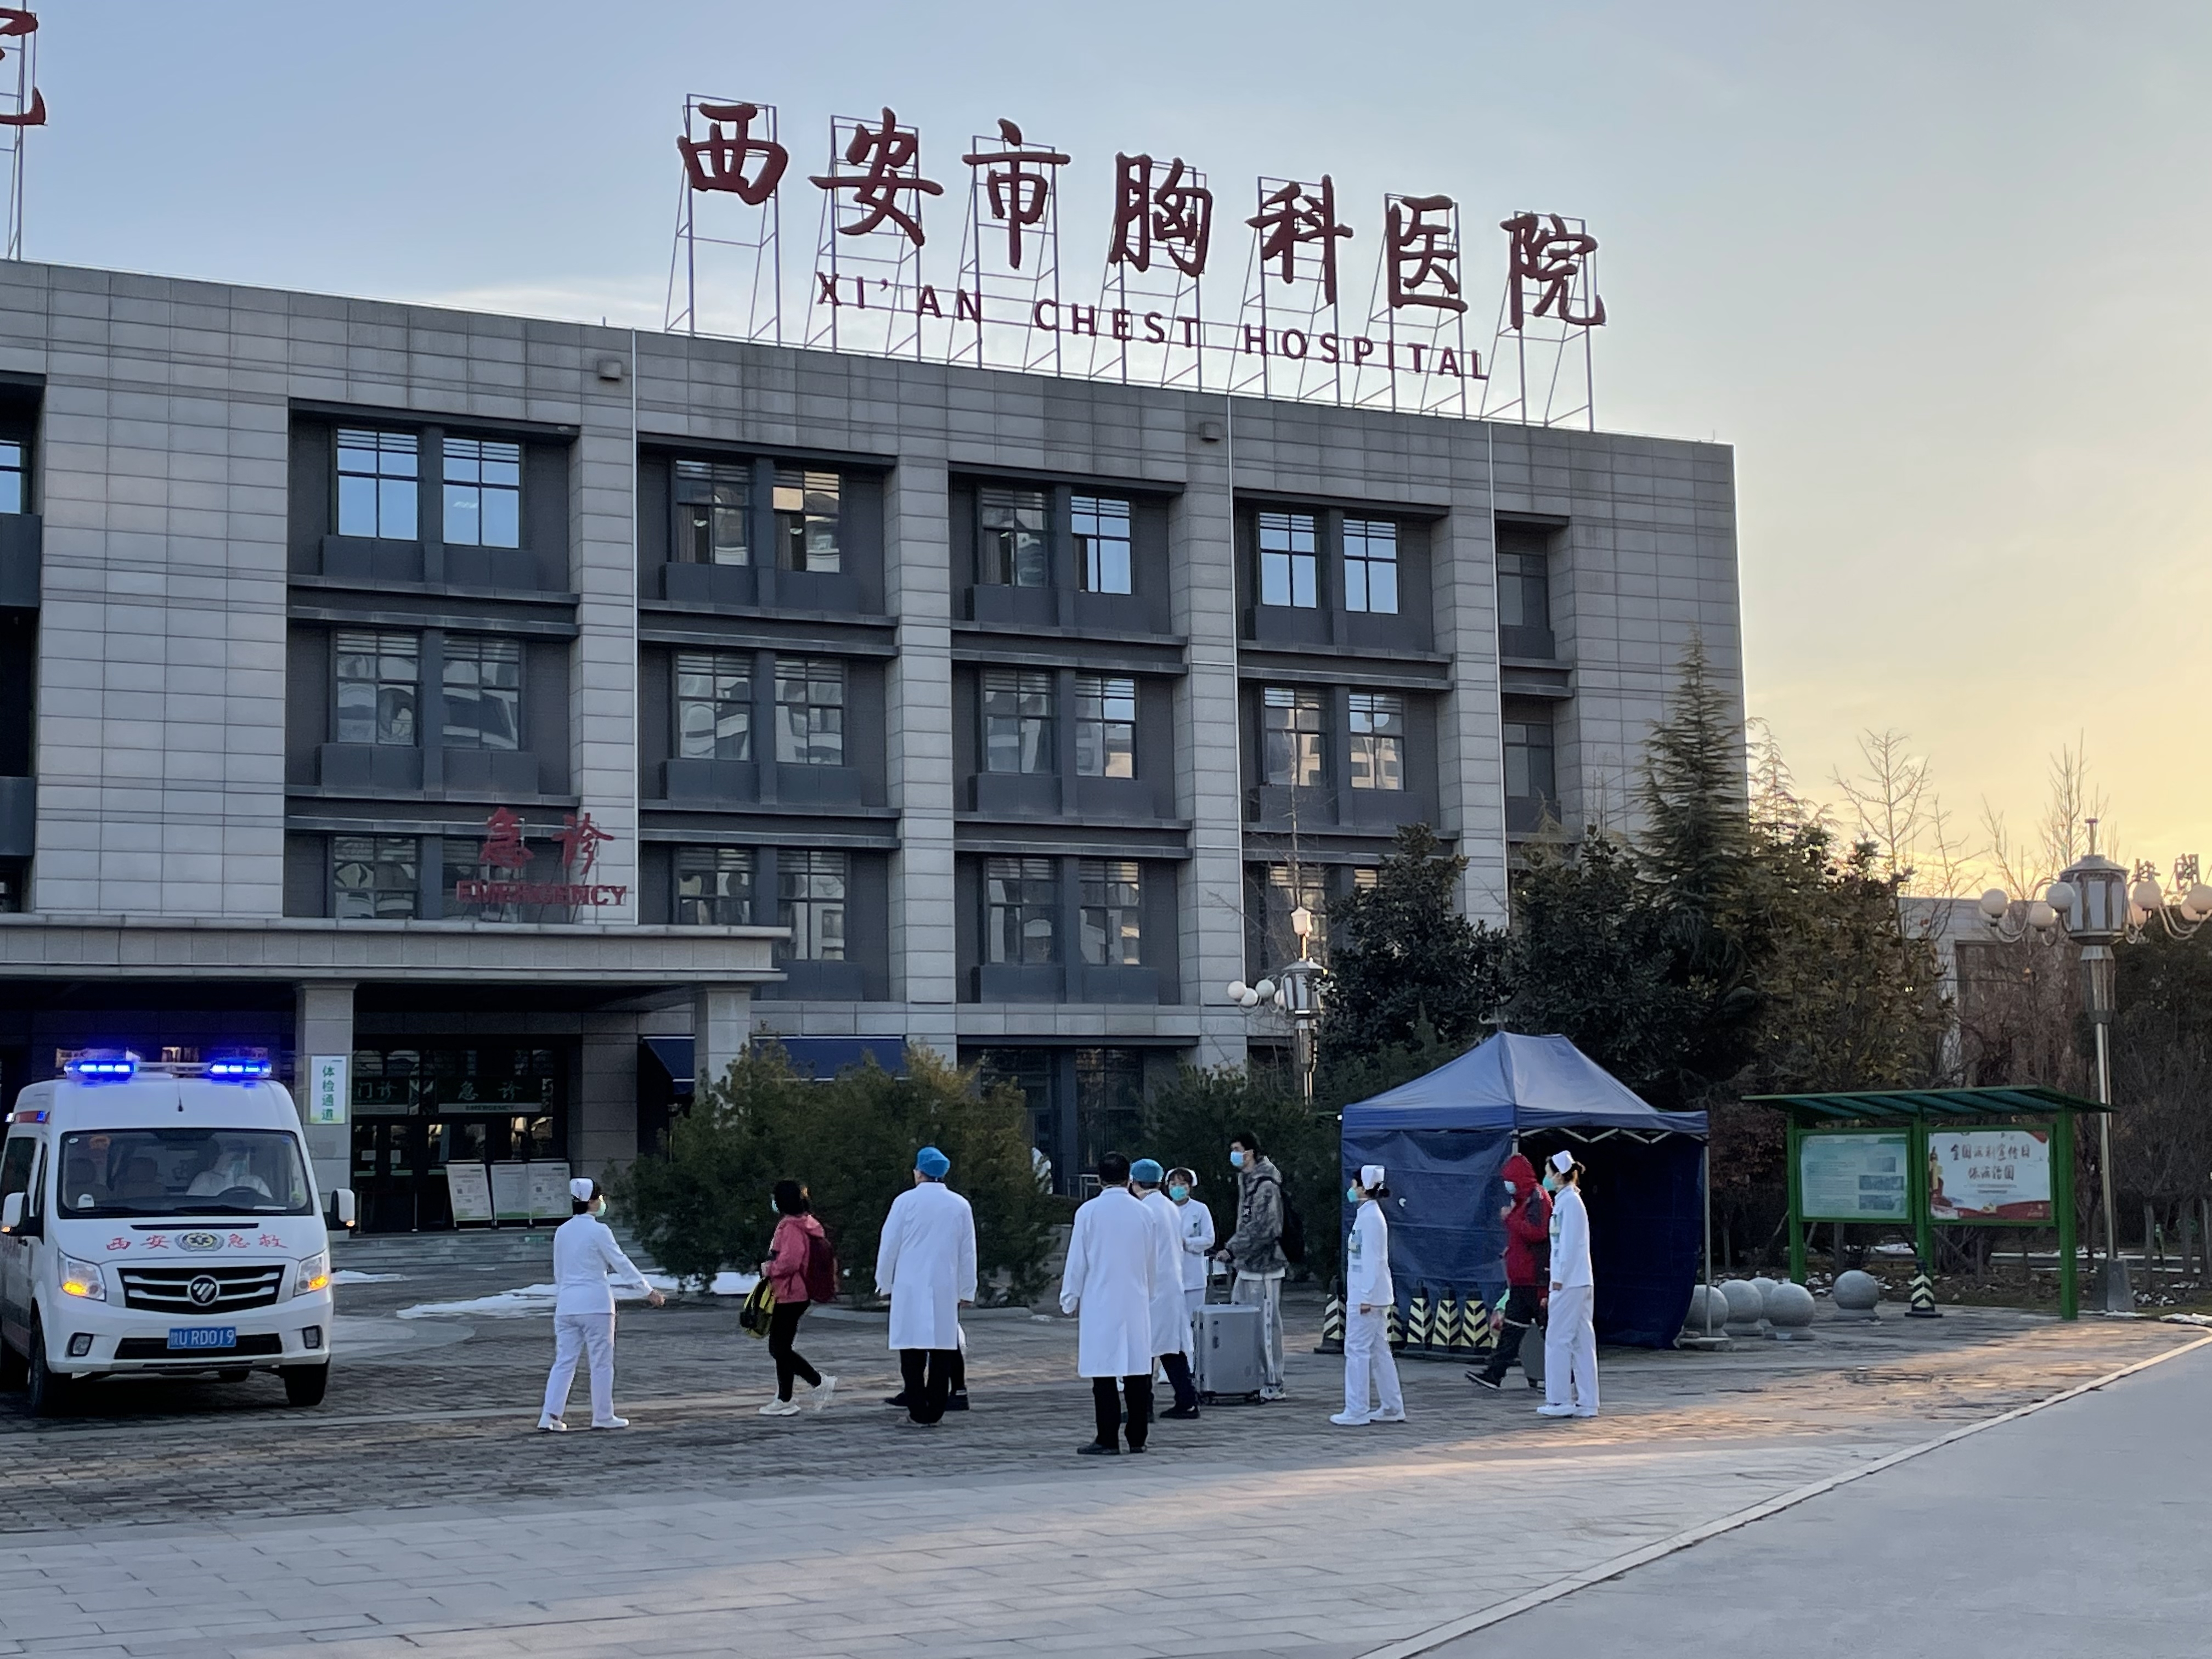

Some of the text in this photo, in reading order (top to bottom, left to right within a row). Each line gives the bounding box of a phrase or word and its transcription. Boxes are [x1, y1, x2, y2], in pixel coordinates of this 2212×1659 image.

[677, 103, 1606, 330] 西安市胸科医院
[1035, 298, 1200, 348] CHEST
[1244, 323, 1488, 380] HOSPITAL
[479, 806, 614, 876] 急诊
[456, 881, 627, 906] EMERGENCY
[321, 1065, 336, 1121] 体检通道
[458, 1080, 523, 1101] 急诊
[106, 1233, 288, 1250] 西安 急救
